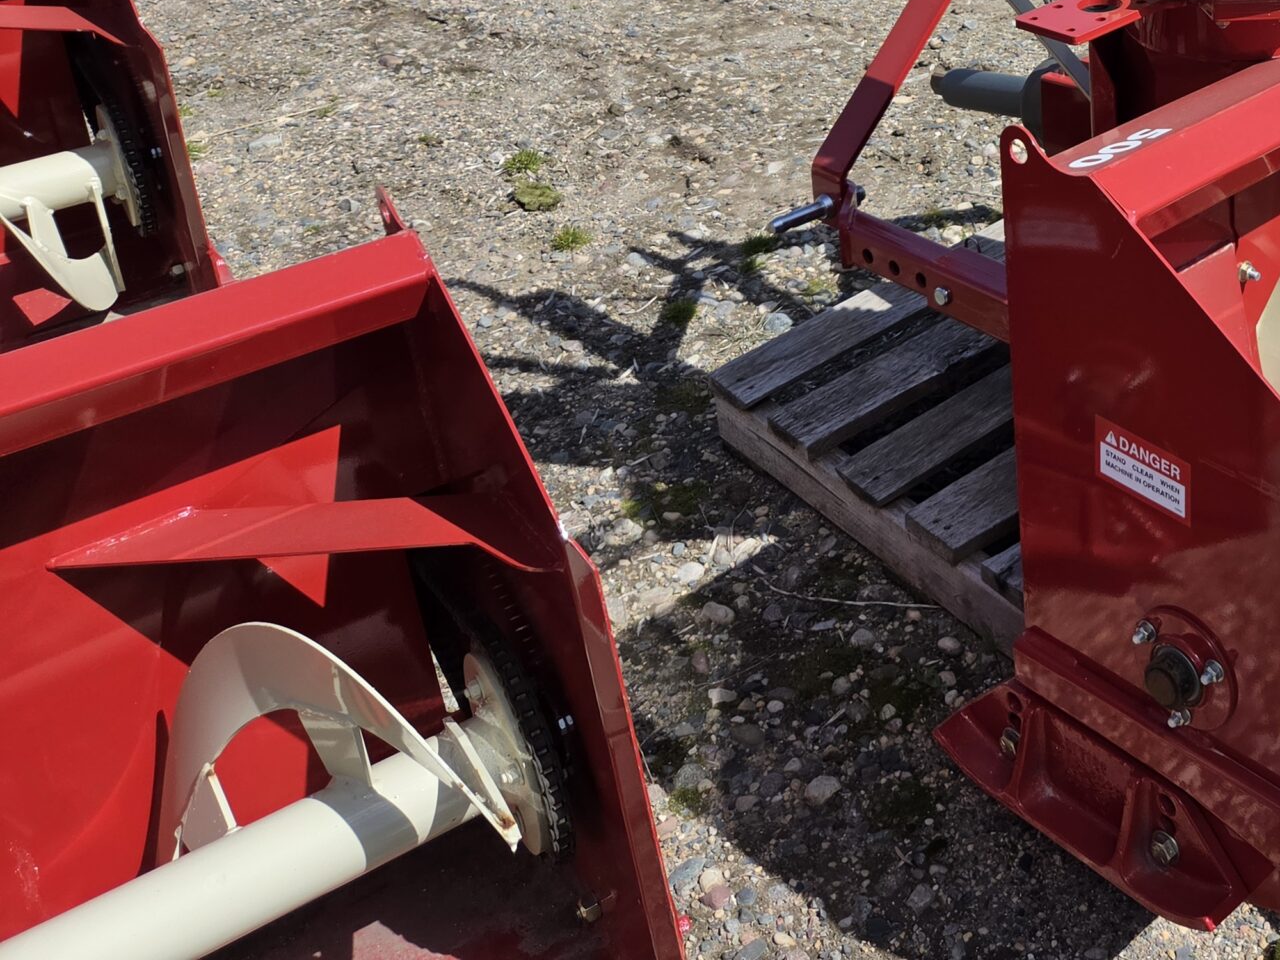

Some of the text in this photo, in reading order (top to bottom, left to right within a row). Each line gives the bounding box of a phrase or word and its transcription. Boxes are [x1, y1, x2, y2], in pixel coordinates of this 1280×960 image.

[1068, 128, 1173, 168] 500
[1105, 449, 1180, 495] STAND CLEAR WHEN
[1119, 435, 1181, 480] DANGER
[1105, 460, 1180, 505] MACHINE IN OPERATION
